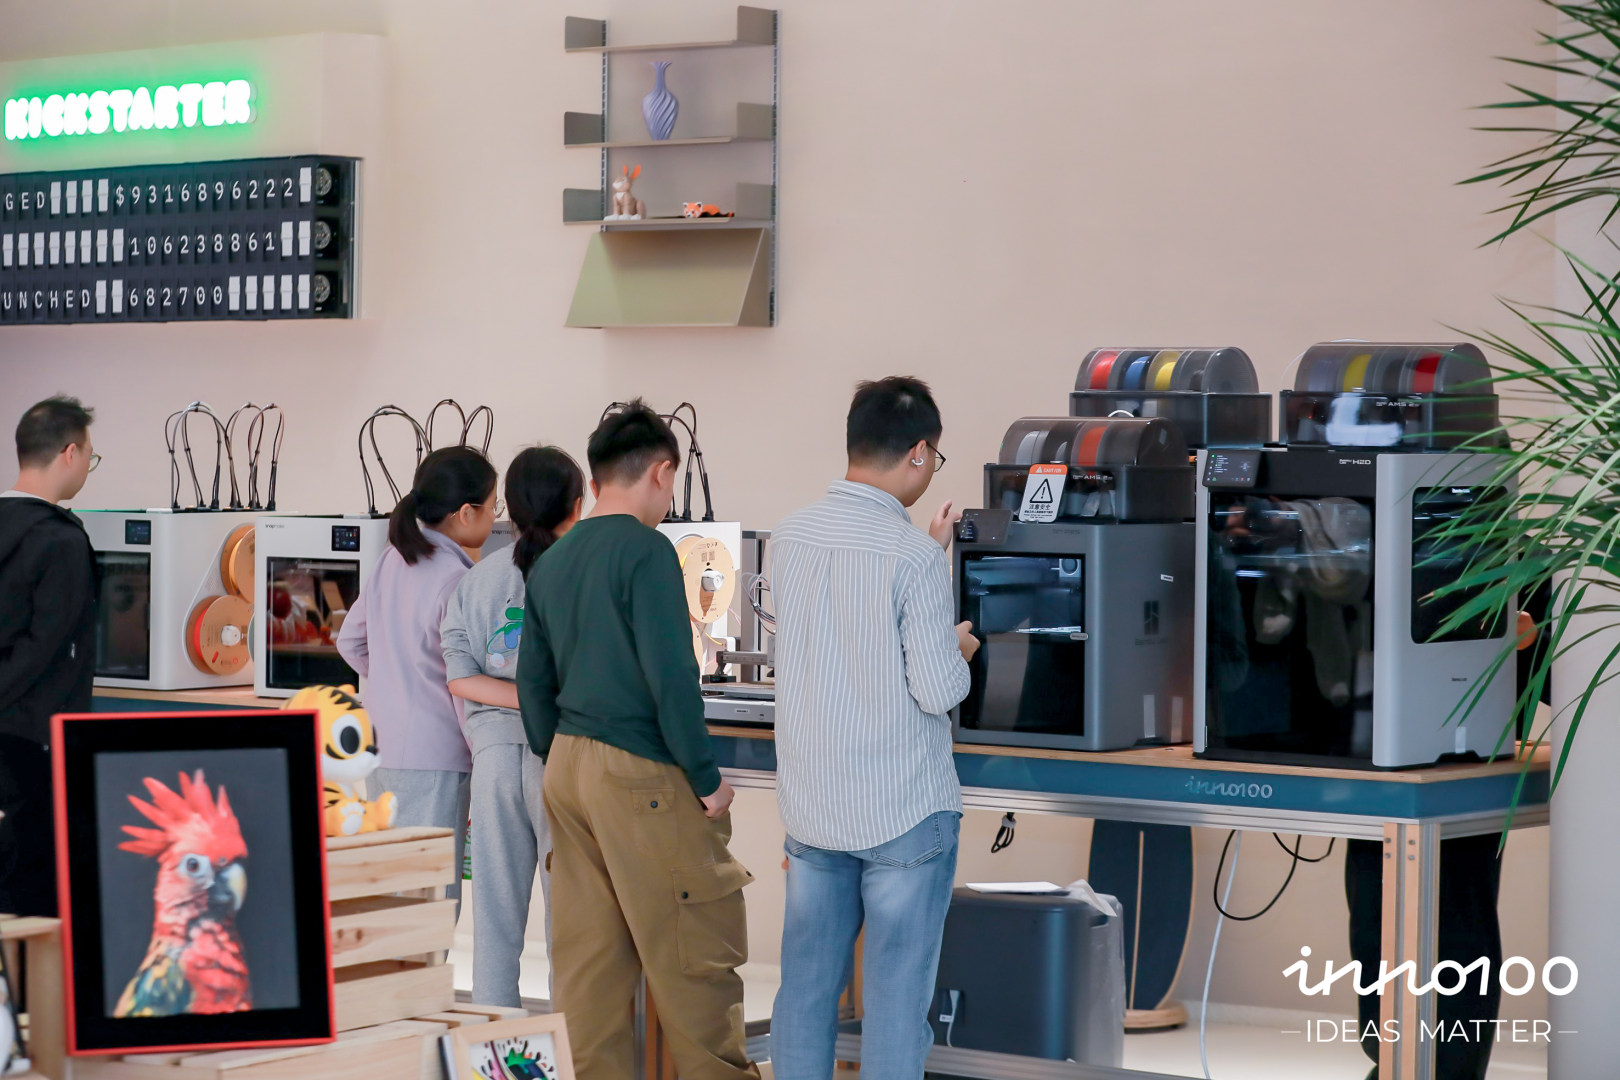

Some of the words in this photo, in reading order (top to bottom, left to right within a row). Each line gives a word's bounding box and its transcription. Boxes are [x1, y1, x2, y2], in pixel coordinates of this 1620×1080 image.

[5, 80, 251, 140] KICKSTARTER
[5, 191, 45, 210] GED
[115, 177, 293, 207] $9316896222
[130, 231, 275, 256] 106238861
[3, 289, 90, 310] UNCHED
[130, 286, 223, 307] 682700
[1184, 775, 1273, 799] inno100
